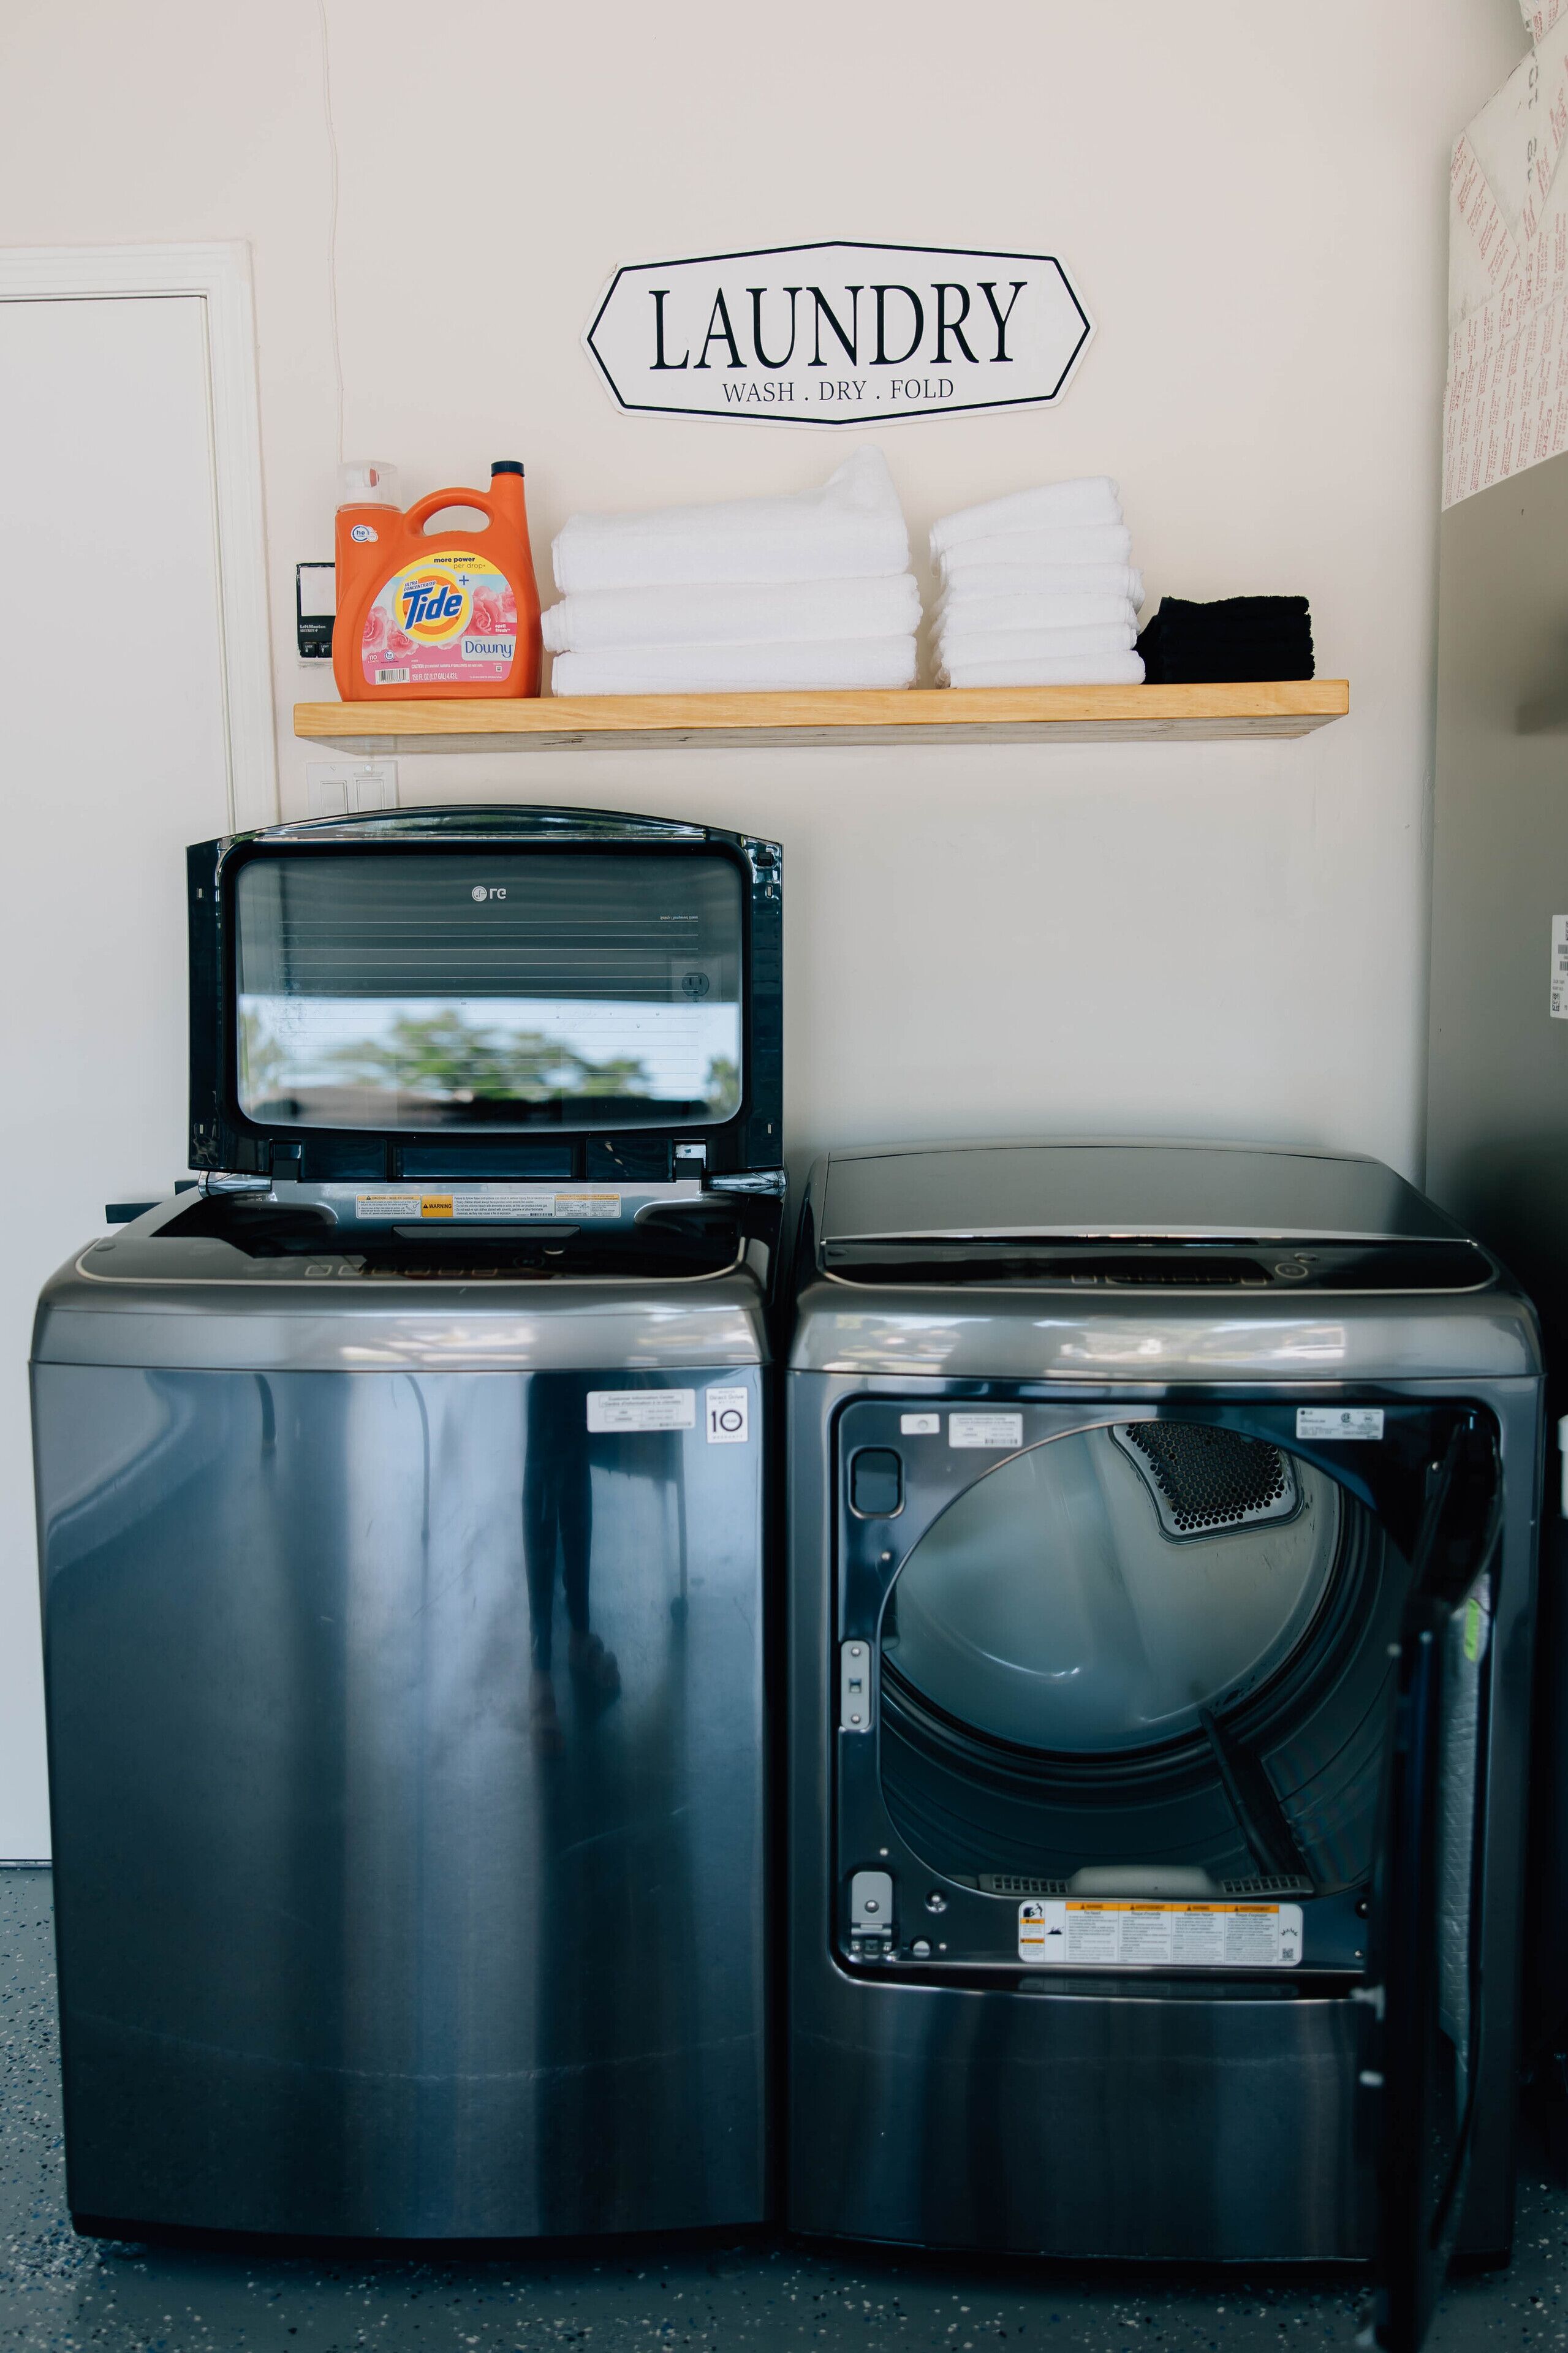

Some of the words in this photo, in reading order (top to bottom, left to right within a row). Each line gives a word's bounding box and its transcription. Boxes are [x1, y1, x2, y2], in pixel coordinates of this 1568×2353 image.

[648, 281, 1028, 370] LAUNDRY
[722, 382, 795, 403] WASH
[819, 381, 867, 402] DRY
[890, 379, 953, 400] FOLD
[1542, 409, 1552, 457] Q4-23
[403, 581, 436, 591] CONCENTRATED
[403, 586, 463, 630] Tide
[465, 640, 512, 658] Downy
[712, 1410, 743, 1432] 10
